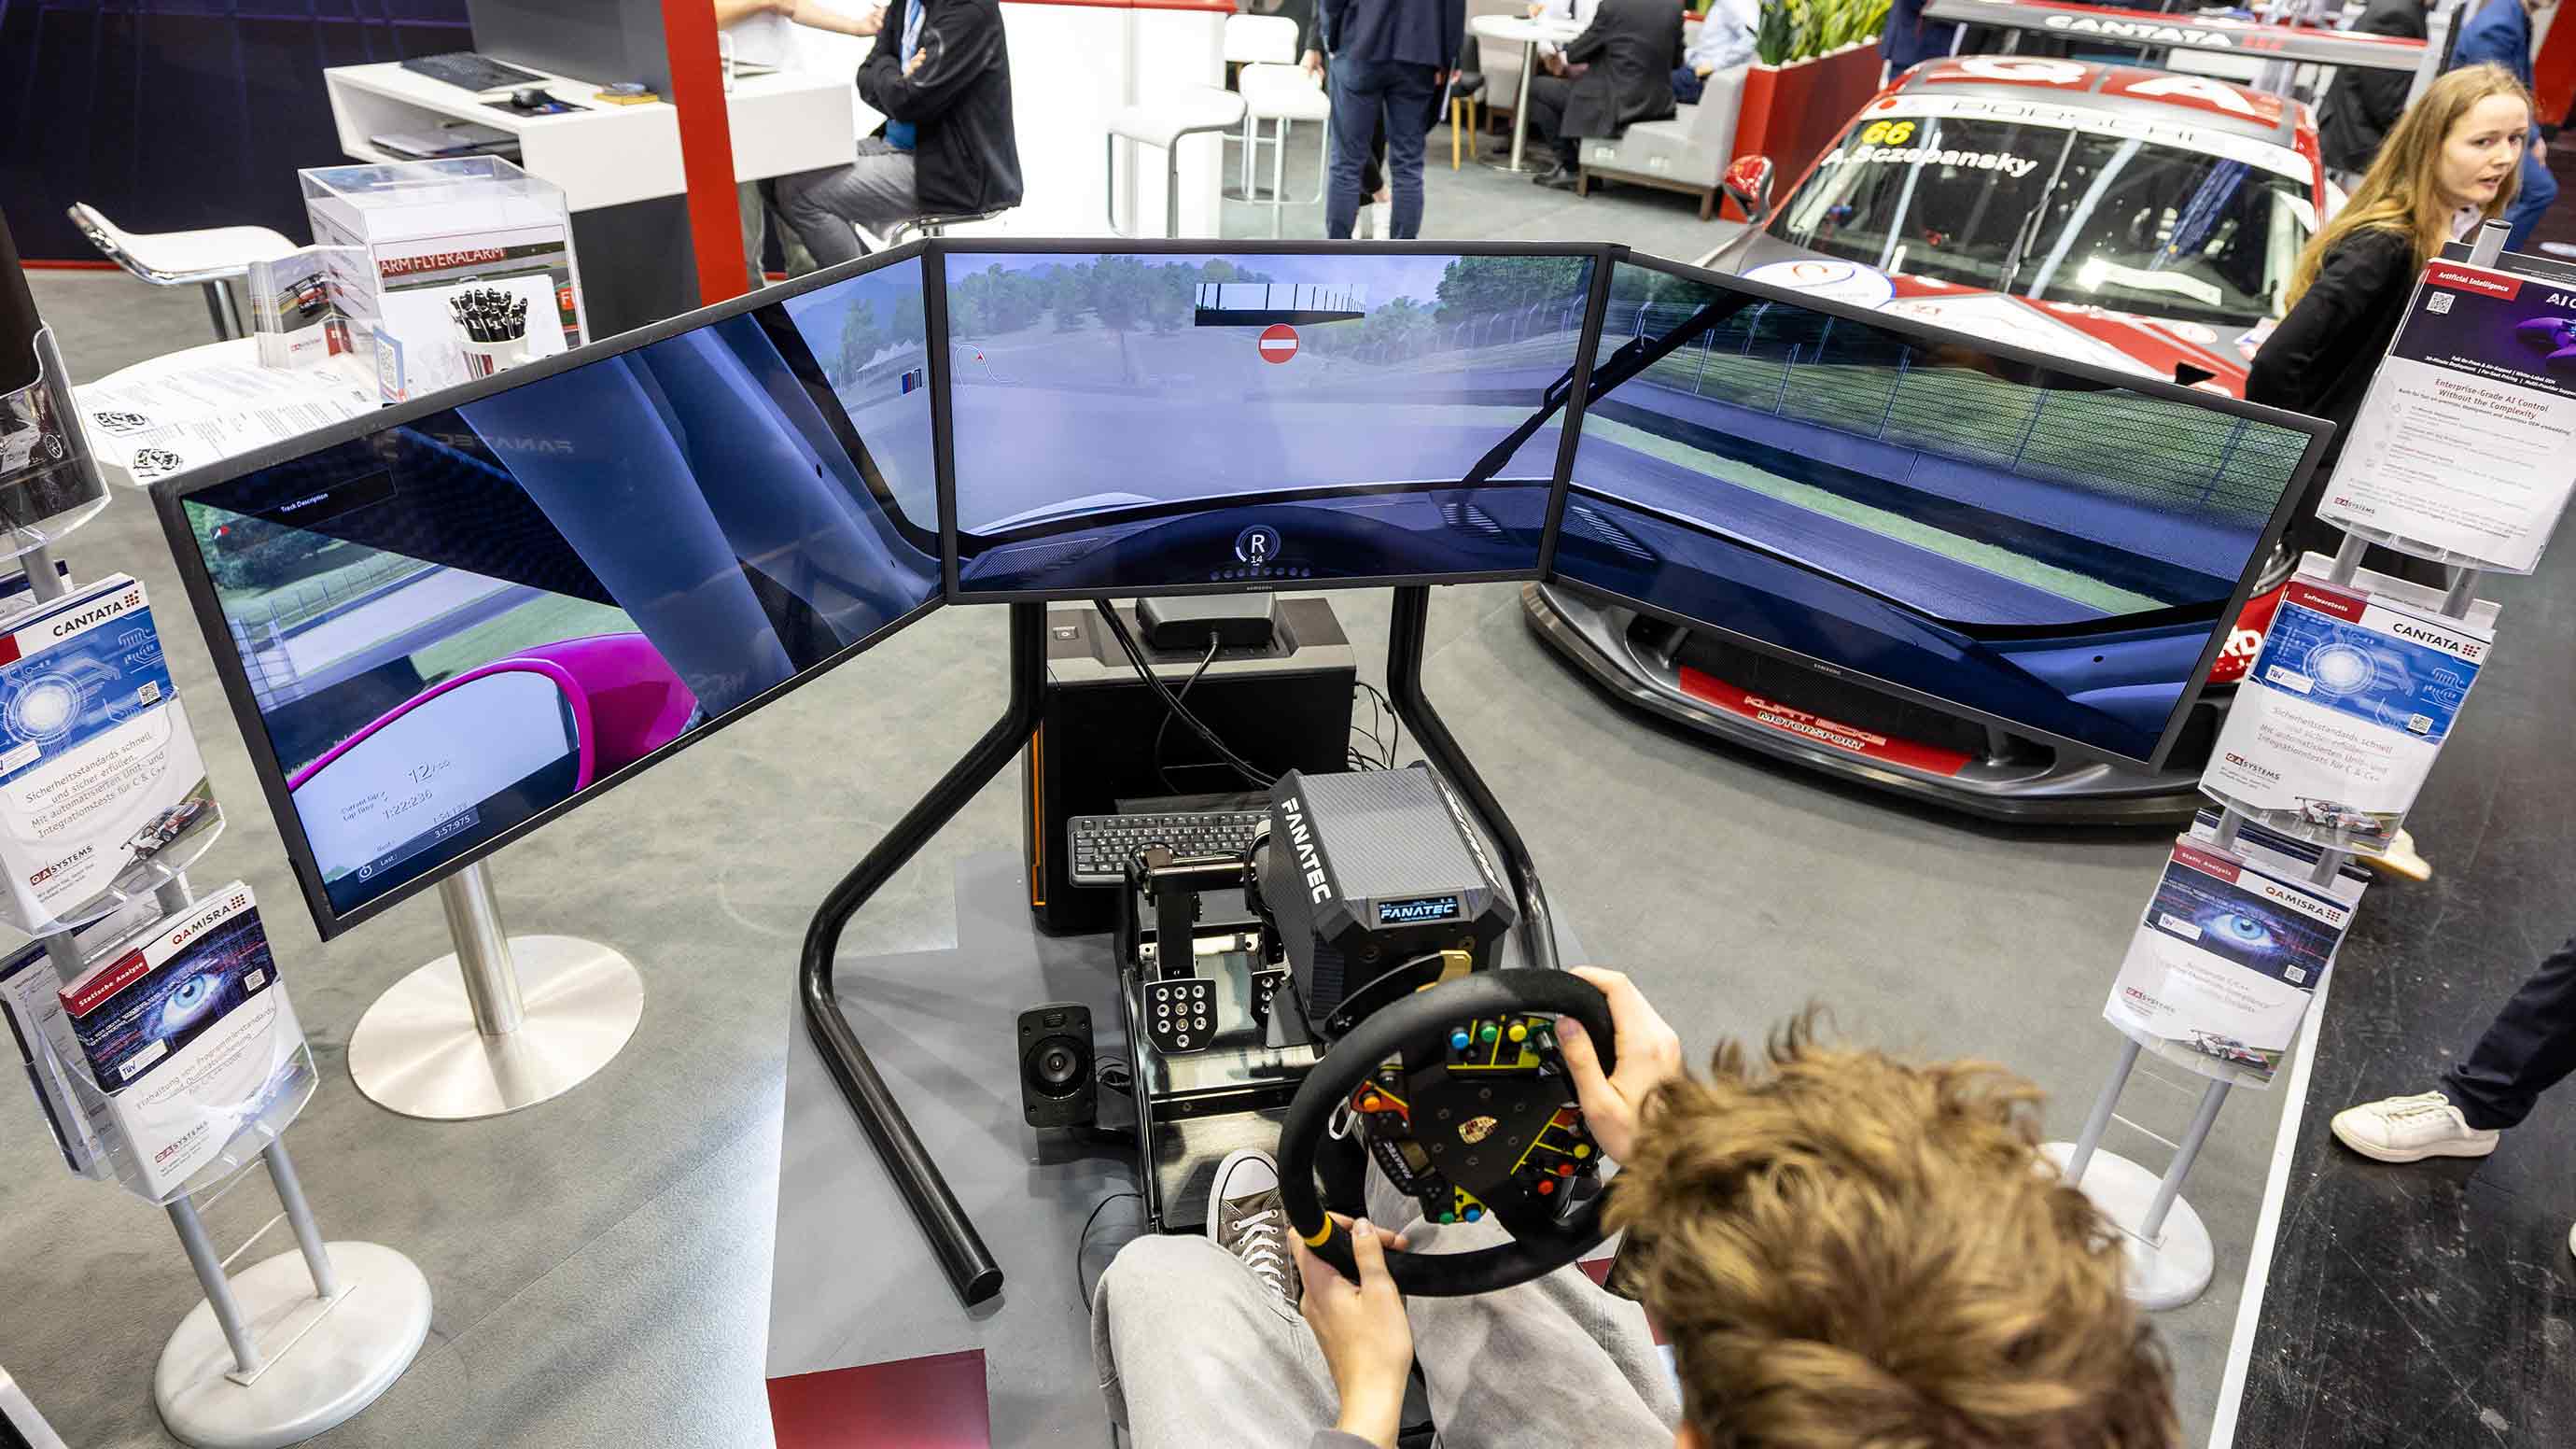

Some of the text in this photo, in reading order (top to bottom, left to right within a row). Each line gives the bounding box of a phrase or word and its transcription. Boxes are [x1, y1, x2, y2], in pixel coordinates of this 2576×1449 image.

[2045, 15, 2232, 47] CANTATA
[1862, 120, 1915, 145] 66
[413, 247, 505, 270] FLYERALARM
[2438, 271, 2510, 293] Artificial Intelligence
[2435, 378, 2549, 412] Enterprise-Grade AI Control
[2440, 389, 2538, 419] Without the Complexity
[281, 492, 329, 513] Track Description
[1252, 534, 1266, 553] R
[1251, 555, 1263, 564] 14
[2303, 591, 2349, 612] Softwaretests
[52, 601, 123, 638] CANTATA
[2392, 623, 2459, 653] CANTATA
[1757, 710, 1865, 751] MOTORSPORT
[25, 748, 119, 804] Sicherheitsstandards
[121, 732, 152, 753] schnell
[2242, 759, 2281, 781] SYSTEMS
[32, 816, 48, 829] Mit
[50, 775, 119, 820] automatisierten
[147, 752, 164, 767] und
[51, 790, 69, 804] und
[72, 774, 98, 793] sicher
[37, 792, 115, 838] Integrationstests
[118, 783, 132, 794] für
[434, 815, 470, 839] 3:57:975
[30, 868, 52, 886] QA
[50, 845, 93, 874] SYSTEMS
[1281, 797, 1333, 905] FANATEC
[1381, 904, 1455, 920] FANATEC
[2265, 886, 2324, 917] QAMISRA
[172, 904, 231, 947] QAMISRA
[78, 962, 144, 1007] Statische Analyse
[122, 1062, 135, 1076] TÜV
[173, 1120, 208, 1150] SYSTEMS
